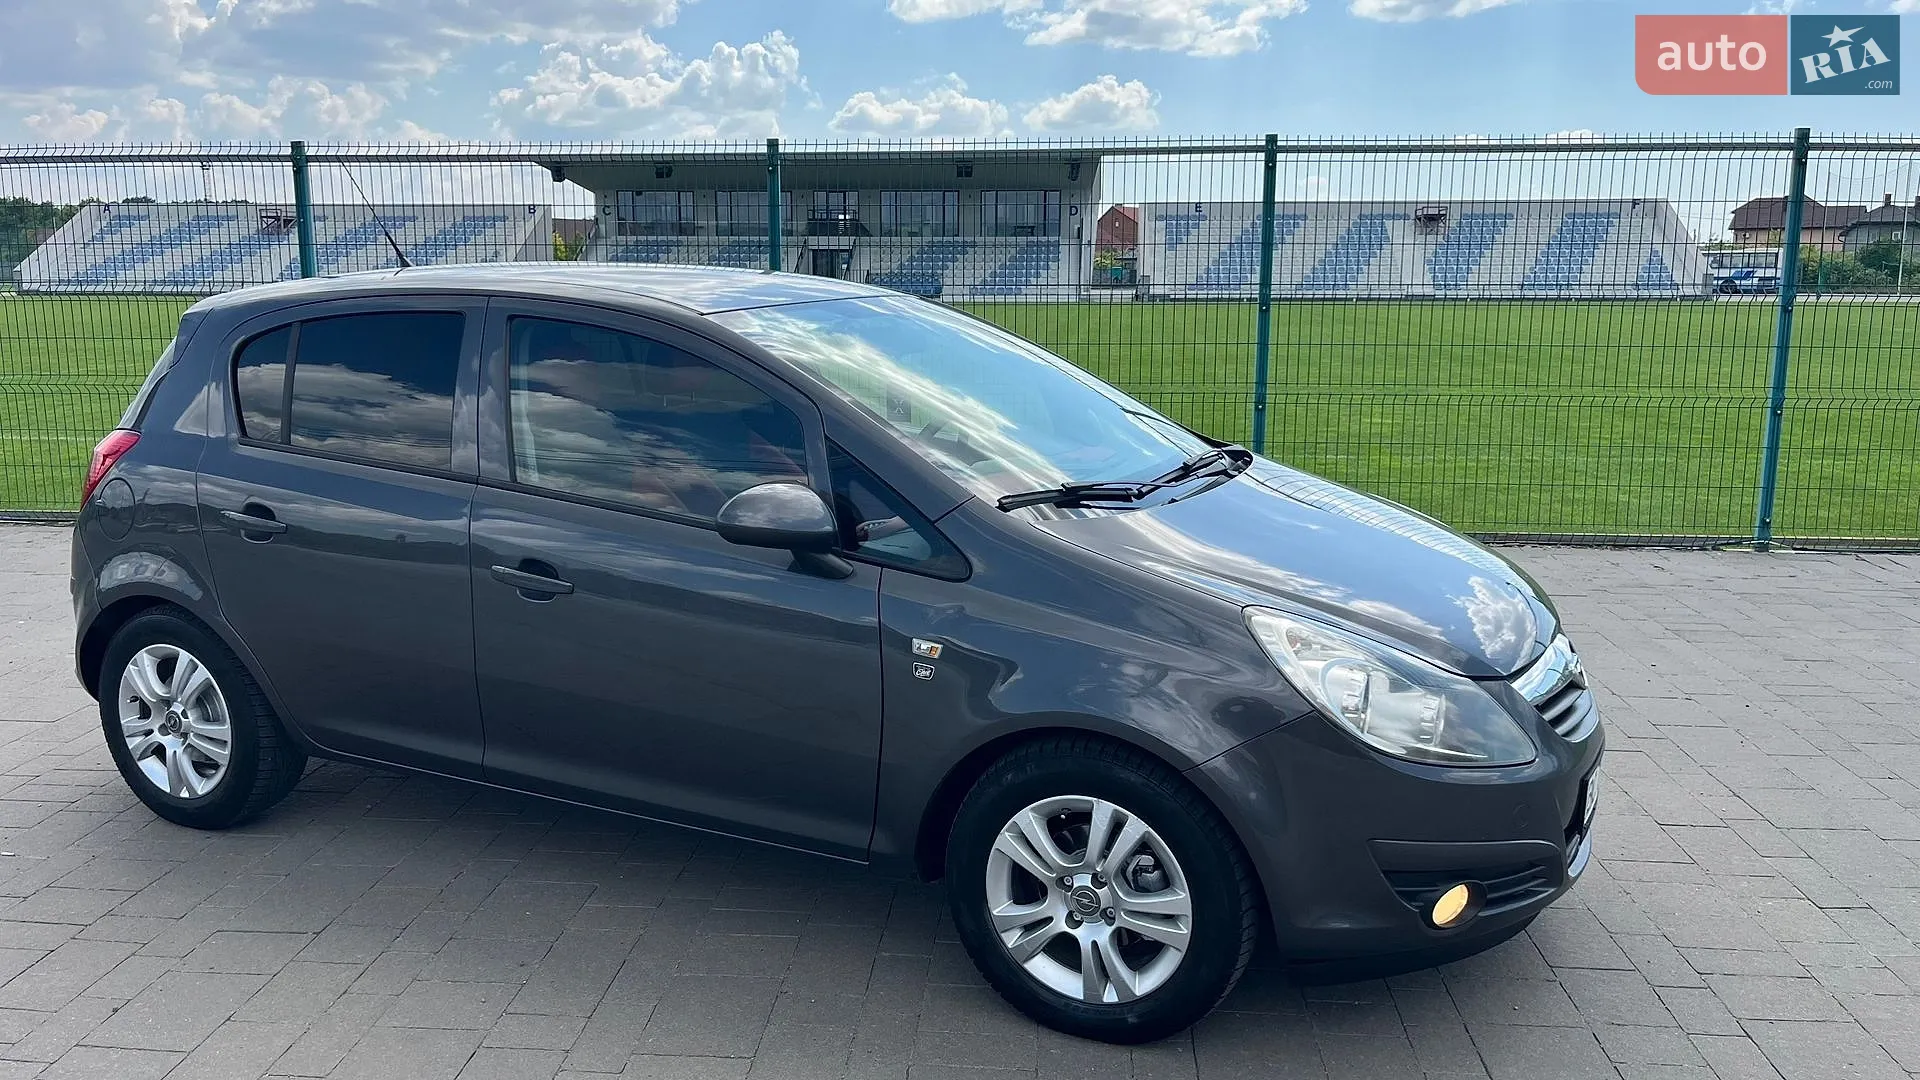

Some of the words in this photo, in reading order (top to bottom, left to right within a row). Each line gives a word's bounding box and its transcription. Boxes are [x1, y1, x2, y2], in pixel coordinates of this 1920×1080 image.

[104, 204, 111, 213] A
[529, 204, 536, 214] B
[603, 206, 611, 215] C
[1070, 206, 1078, 216] D
[1195, 202, 1202, 212] E
